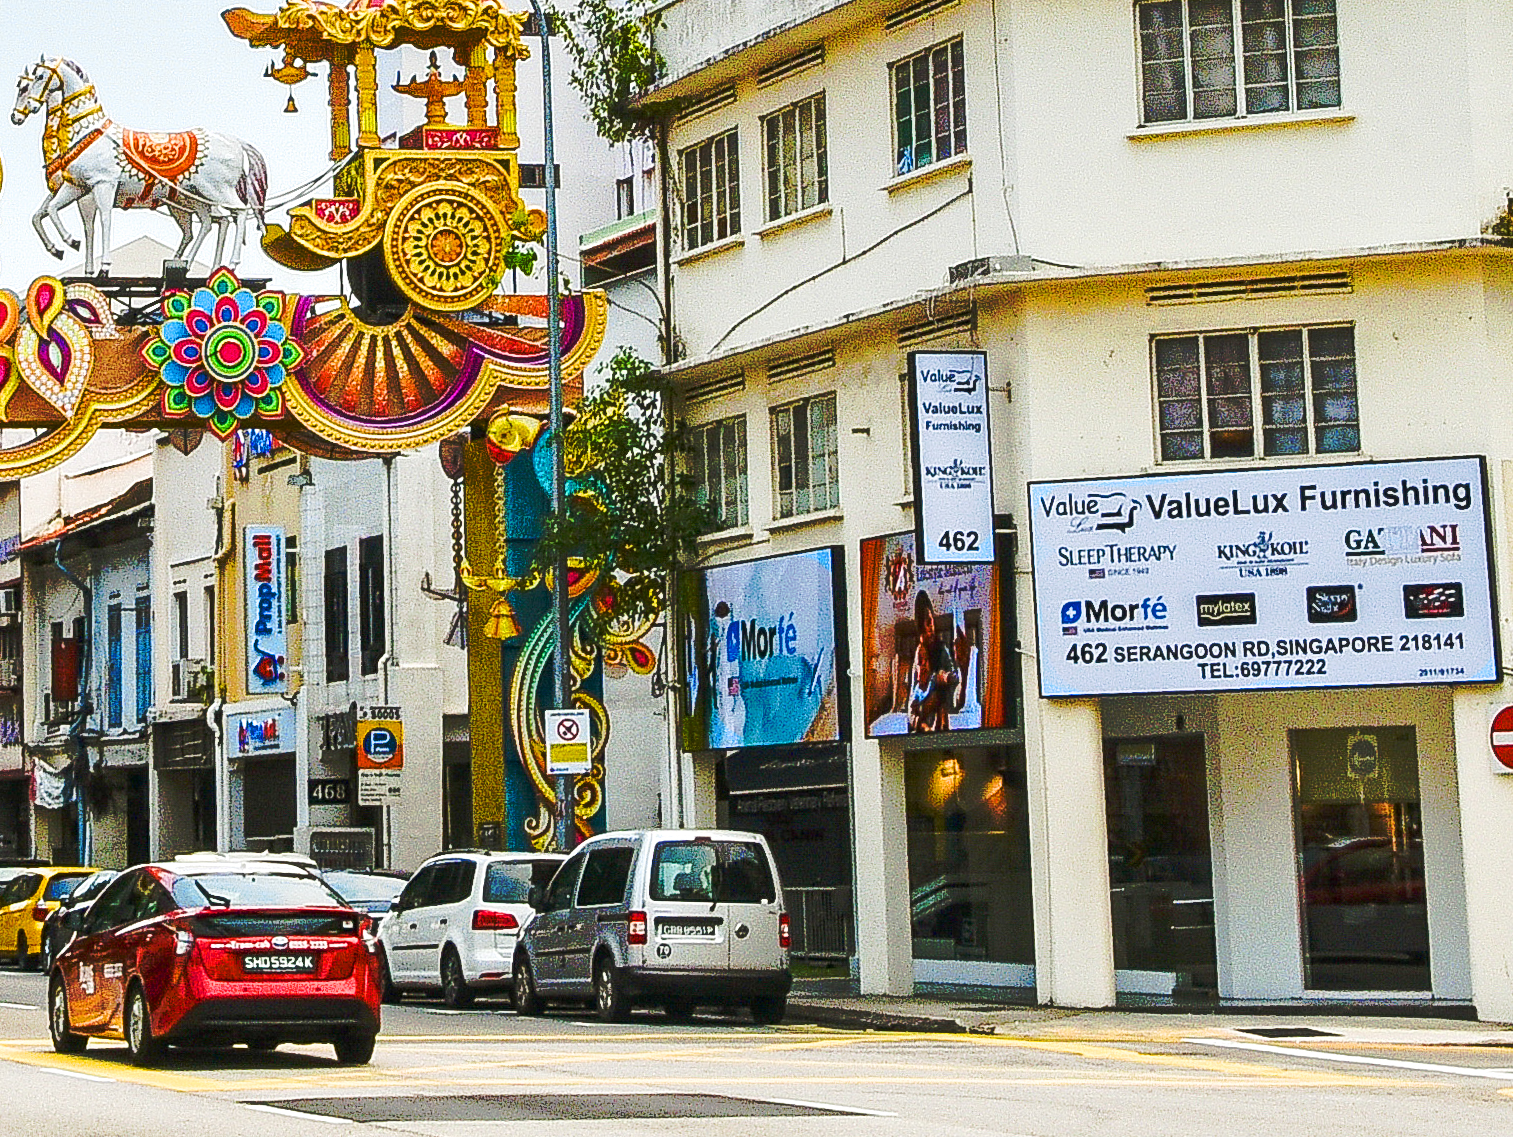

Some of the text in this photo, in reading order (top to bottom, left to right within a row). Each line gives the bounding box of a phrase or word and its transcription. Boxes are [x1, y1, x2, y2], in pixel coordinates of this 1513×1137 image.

[921, 369, 957, 383] Value
[923, 402, 983, 415] ValueLux
[926, 421, 982, 433] Furnishing
[1040, 493, 1099, 518] Value
[1146, 478, 1472, 520] ValueLux Furnishing
[938, 531, 980, 552] 462
[1217, 544, 1256, 561] KING
[1369, 555, 1403, 567] Design
[1405, 553, 1438, 566] Luxury
[252, 535, 277, 637] PropMall
[1084, 595, 1168, 623] Morfé
[1200, 600, 1251, 615] mylatex
[740, 611, 797, 662] Morfé
[1065, 643, 1108, 663] 462
[1113, 642, 1236, 663] SERANGOON
[1399, 632, 1464, 651] 218141
[1197, 659, 1327, 679] TEL:69777222
[312, 784, 346, 800] 468
[244, 956, 313, 969] SHD5924K
